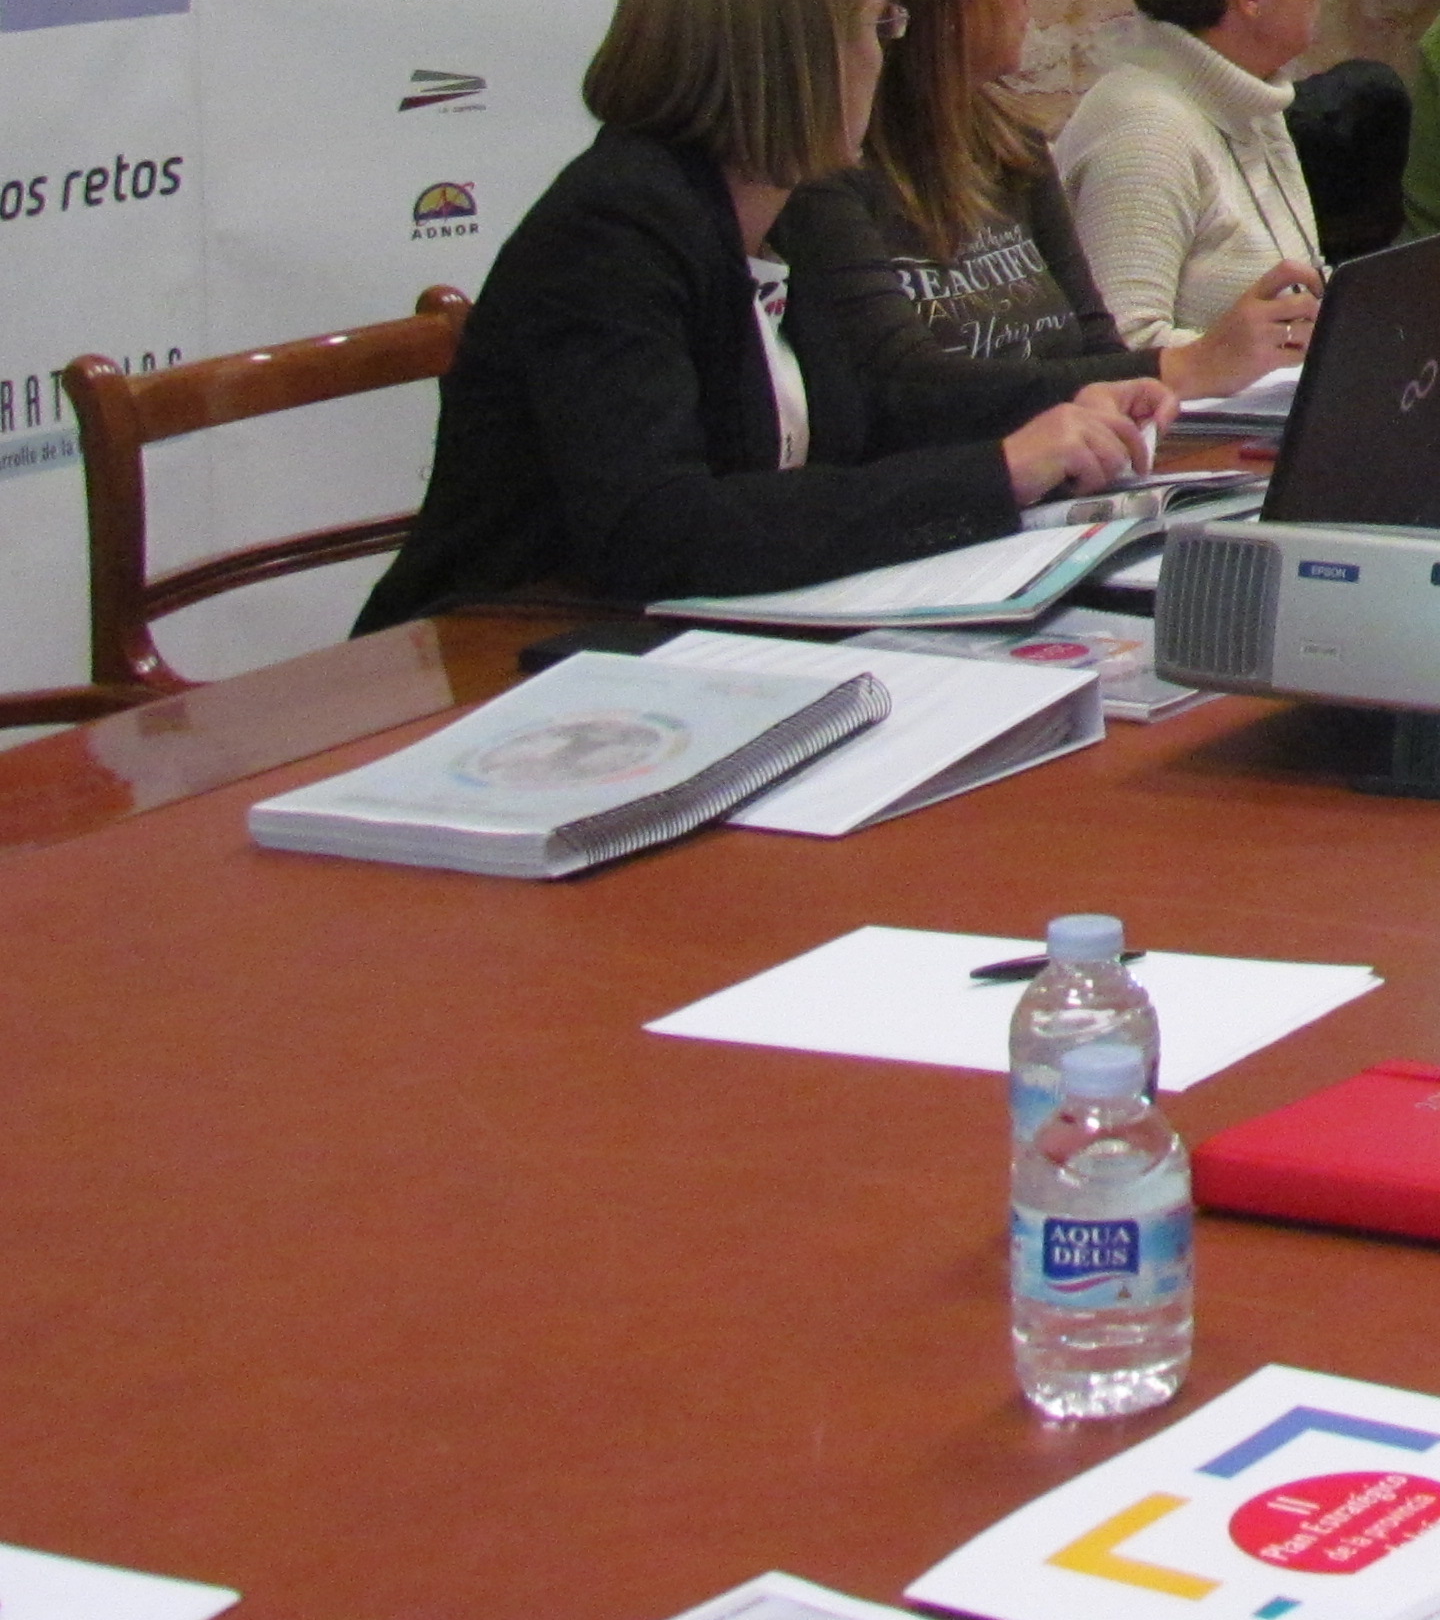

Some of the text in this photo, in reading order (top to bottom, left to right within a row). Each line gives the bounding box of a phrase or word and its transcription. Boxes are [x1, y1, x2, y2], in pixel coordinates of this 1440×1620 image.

[60, 153, 184, 213] retos
[411, 223, 480, 241] ADNOR
[1050, 1224, 1131, 1245] AQUA
[1053, 1244, 1129, 1267] DEUS
